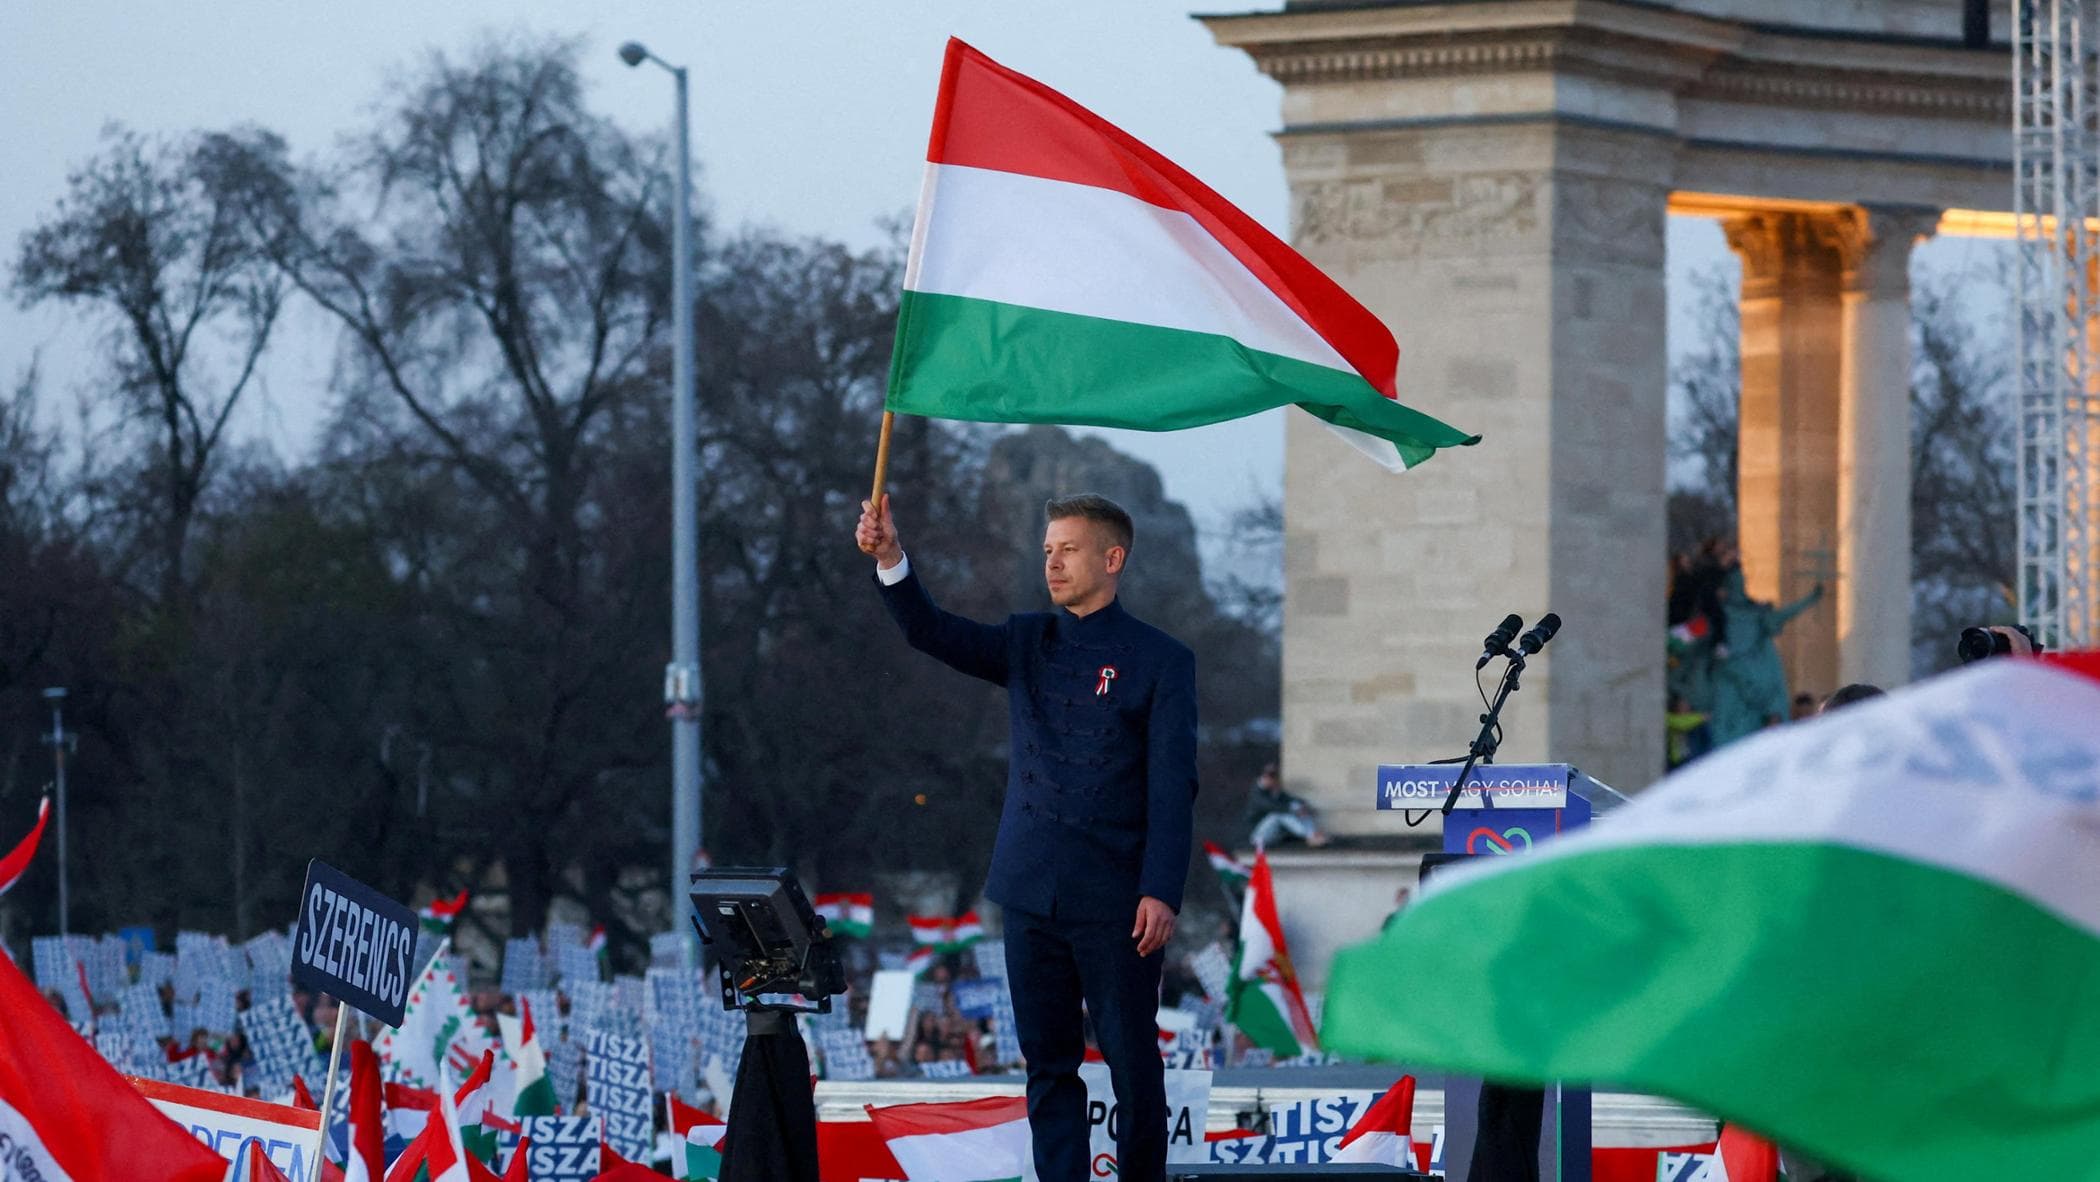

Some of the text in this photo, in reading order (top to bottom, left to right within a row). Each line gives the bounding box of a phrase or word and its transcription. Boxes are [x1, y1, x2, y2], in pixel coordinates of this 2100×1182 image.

[1385, 781, 1439, 797] MOST
[1500, 780, 1558, 797] SOHA!
[301, 882, 411, 1008] SZERENCS
[586, 1029, 649, 1066] TISZA
[587, 1054, 650, 1090] TISZA
[587, 1079, 653, 1117] TISZA
[497, 1146, 601, 1175] TSZA
